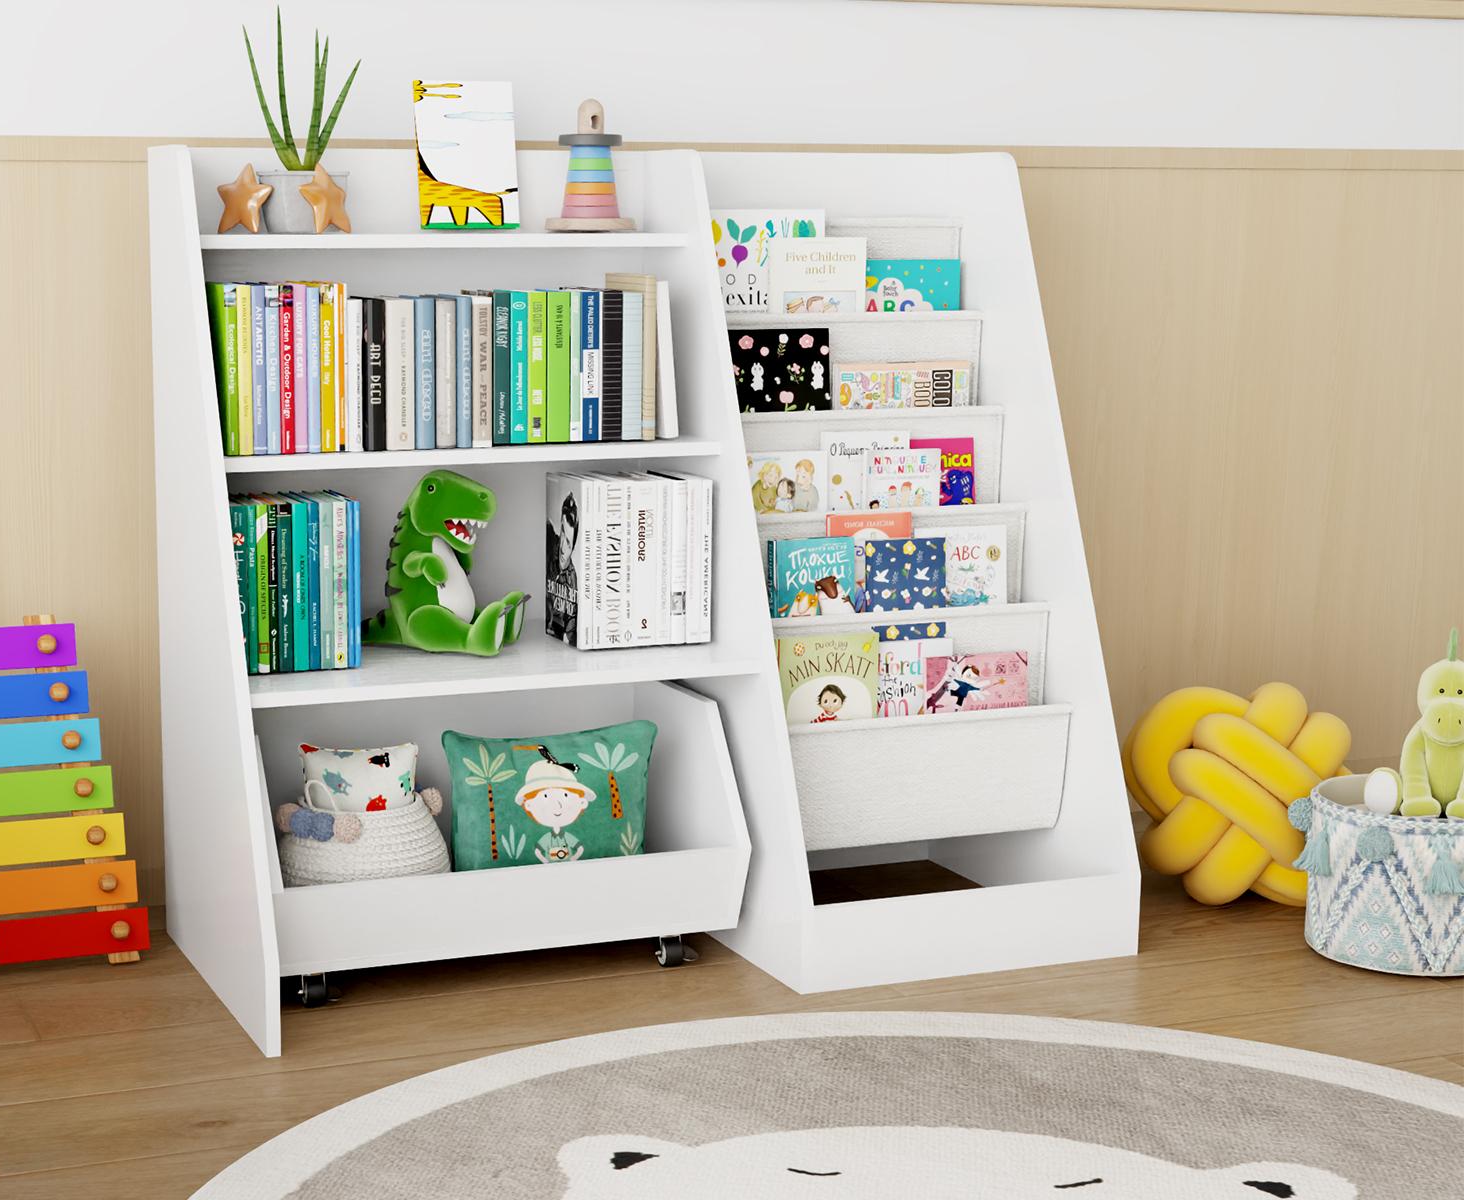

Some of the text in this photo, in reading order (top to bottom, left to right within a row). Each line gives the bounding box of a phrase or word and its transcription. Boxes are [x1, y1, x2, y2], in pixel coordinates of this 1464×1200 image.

[786, 250, 856, 262] Five Children
[805, 264, 836, 275] and It
[866, 299, 915, 312] ABC
[255, 306, 264, 366] ANTARCTIC
[283, 312, 291, 343] Garden
[479, 307, 488, 337] TOLSTOY
[228, 323, 236, 394] Ecological Design
[479, 341, 488, 372] WAR
[269, 357, 277, 392] Design
[370, 343, 382, 405] ART DECO
[932, 371, 952, 407] COLO
[284, 391, 292, 419] Design
[479, 384, 488, 426] PEACE
[914, 381, 931, 408] BOO
[941, 452, 972, 468] nica
[950, 545, 981, 561] ABC
[788, 651, 875, 687] MIN SKATT
[878, 642, 921, 676] tford
